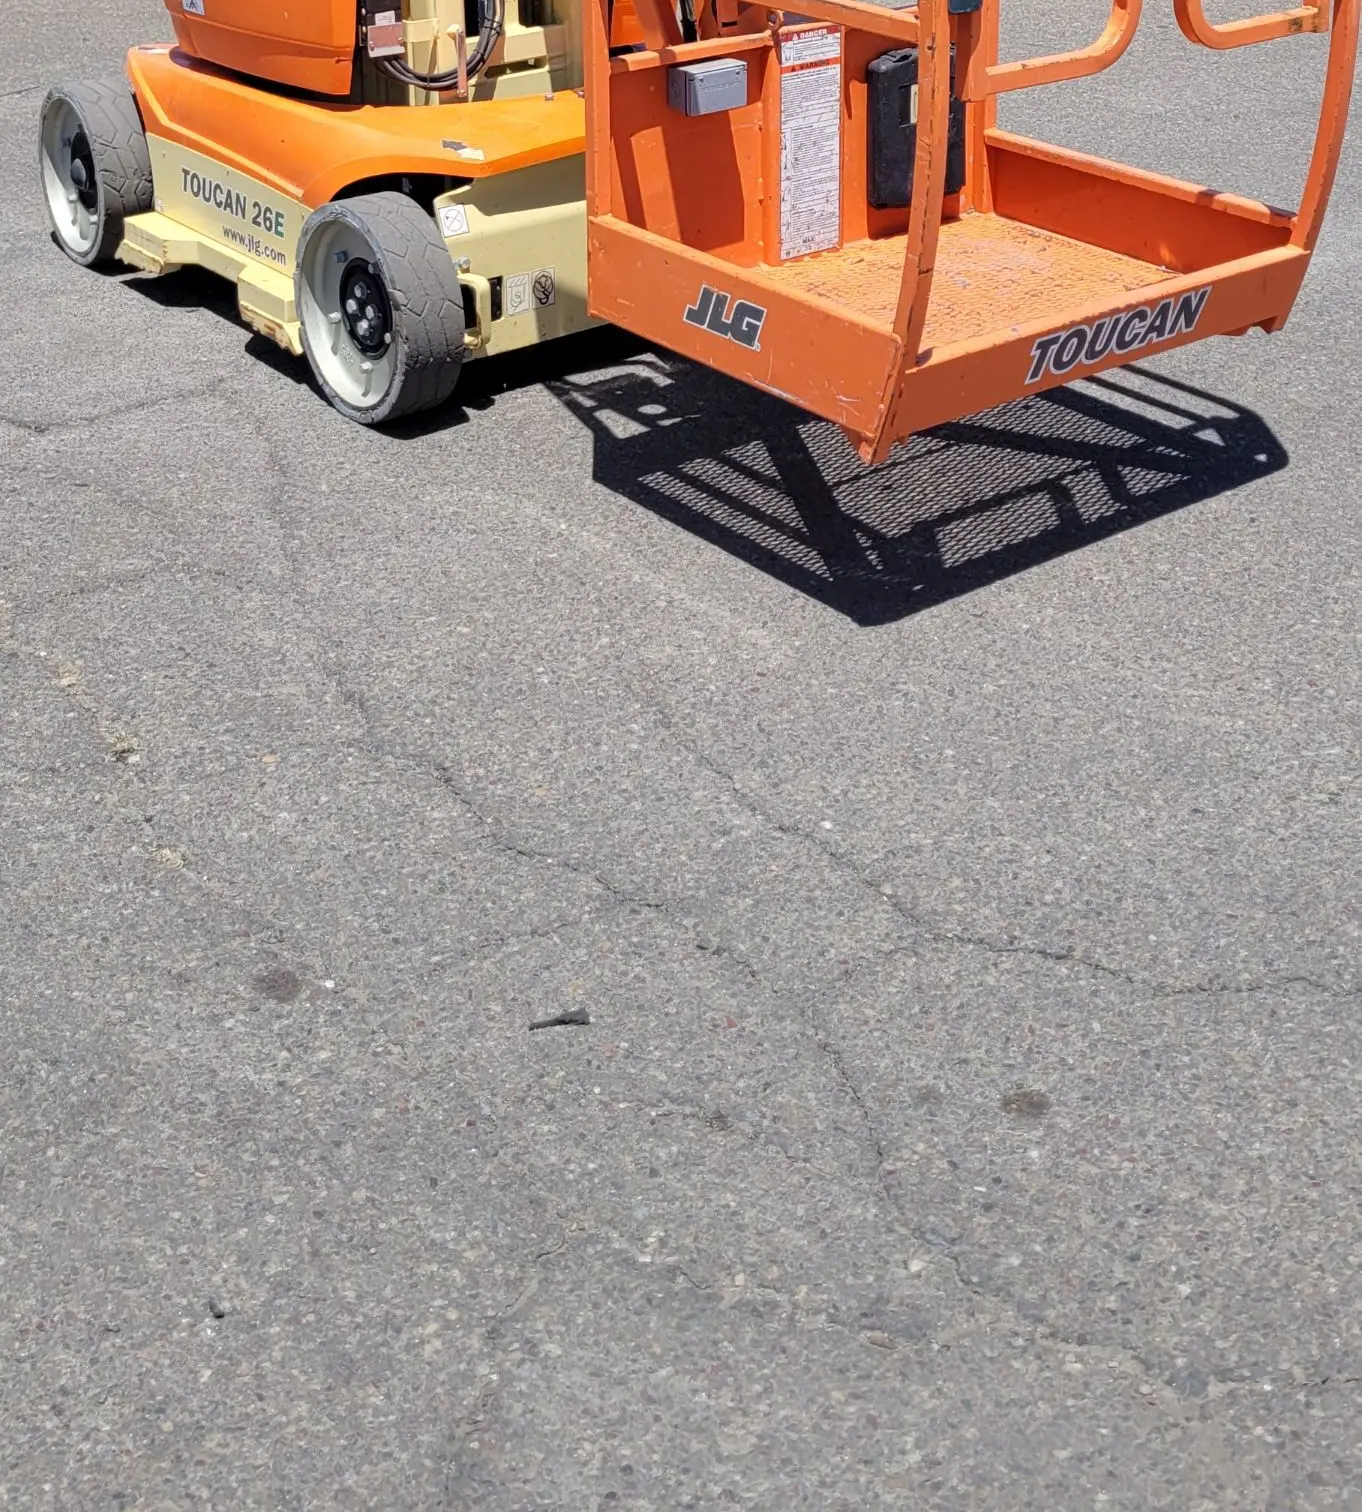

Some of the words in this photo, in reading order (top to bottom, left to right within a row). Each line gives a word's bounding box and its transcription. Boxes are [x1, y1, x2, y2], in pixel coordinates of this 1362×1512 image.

[800, 28, 827, 39] DANGER
[181, 167, 247, 220] TOUCAN
[251, 200, 285, 238] 26E
[222, 225, 287, 266] www.jlg.com
[683, 284, 767, 350] JLG
[1023, 286, 1213, 386] TOUCAN
